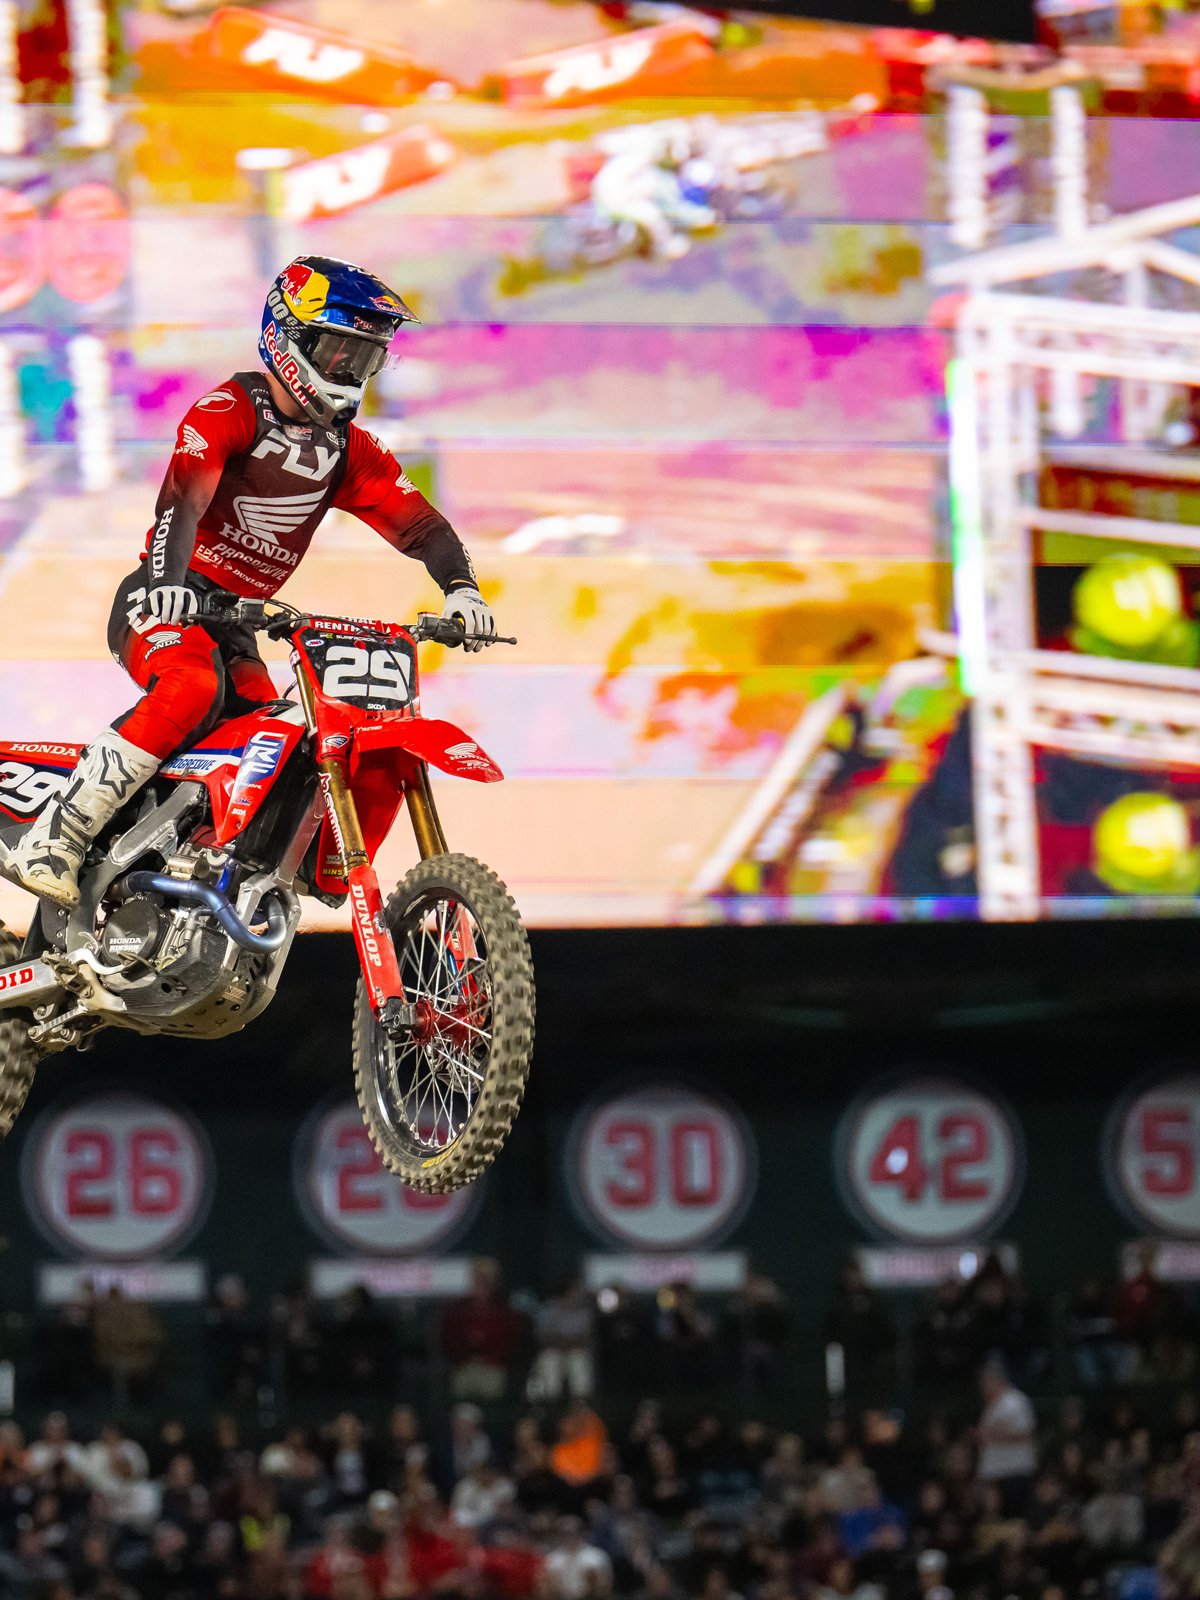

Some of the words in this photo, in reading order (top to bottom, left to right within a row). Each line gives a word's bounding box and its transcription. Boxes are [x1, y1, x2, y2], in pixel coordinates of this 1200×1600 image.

[251, 428, 341, 482] FLY
[152, 506, 175, 579] HONDA
[219, 522, 299, 566] HONDA
[232, 568, 266, 588] DUNLOP
[145, 638, 184, 662] HONDA
[323, 645, 410, 701] 29
[9, 743, 78, 757] HONDA
[165, 758, 216, 771] ROGRESSIVE
[109, 937, 142, 945] HONDA
[351, 884, 382, 967] DUNLOP
[65, 1129, 182, 1217] 26
[606, 1120, 722, 1208] 30
[868, 1115, 990, 1202] 42
